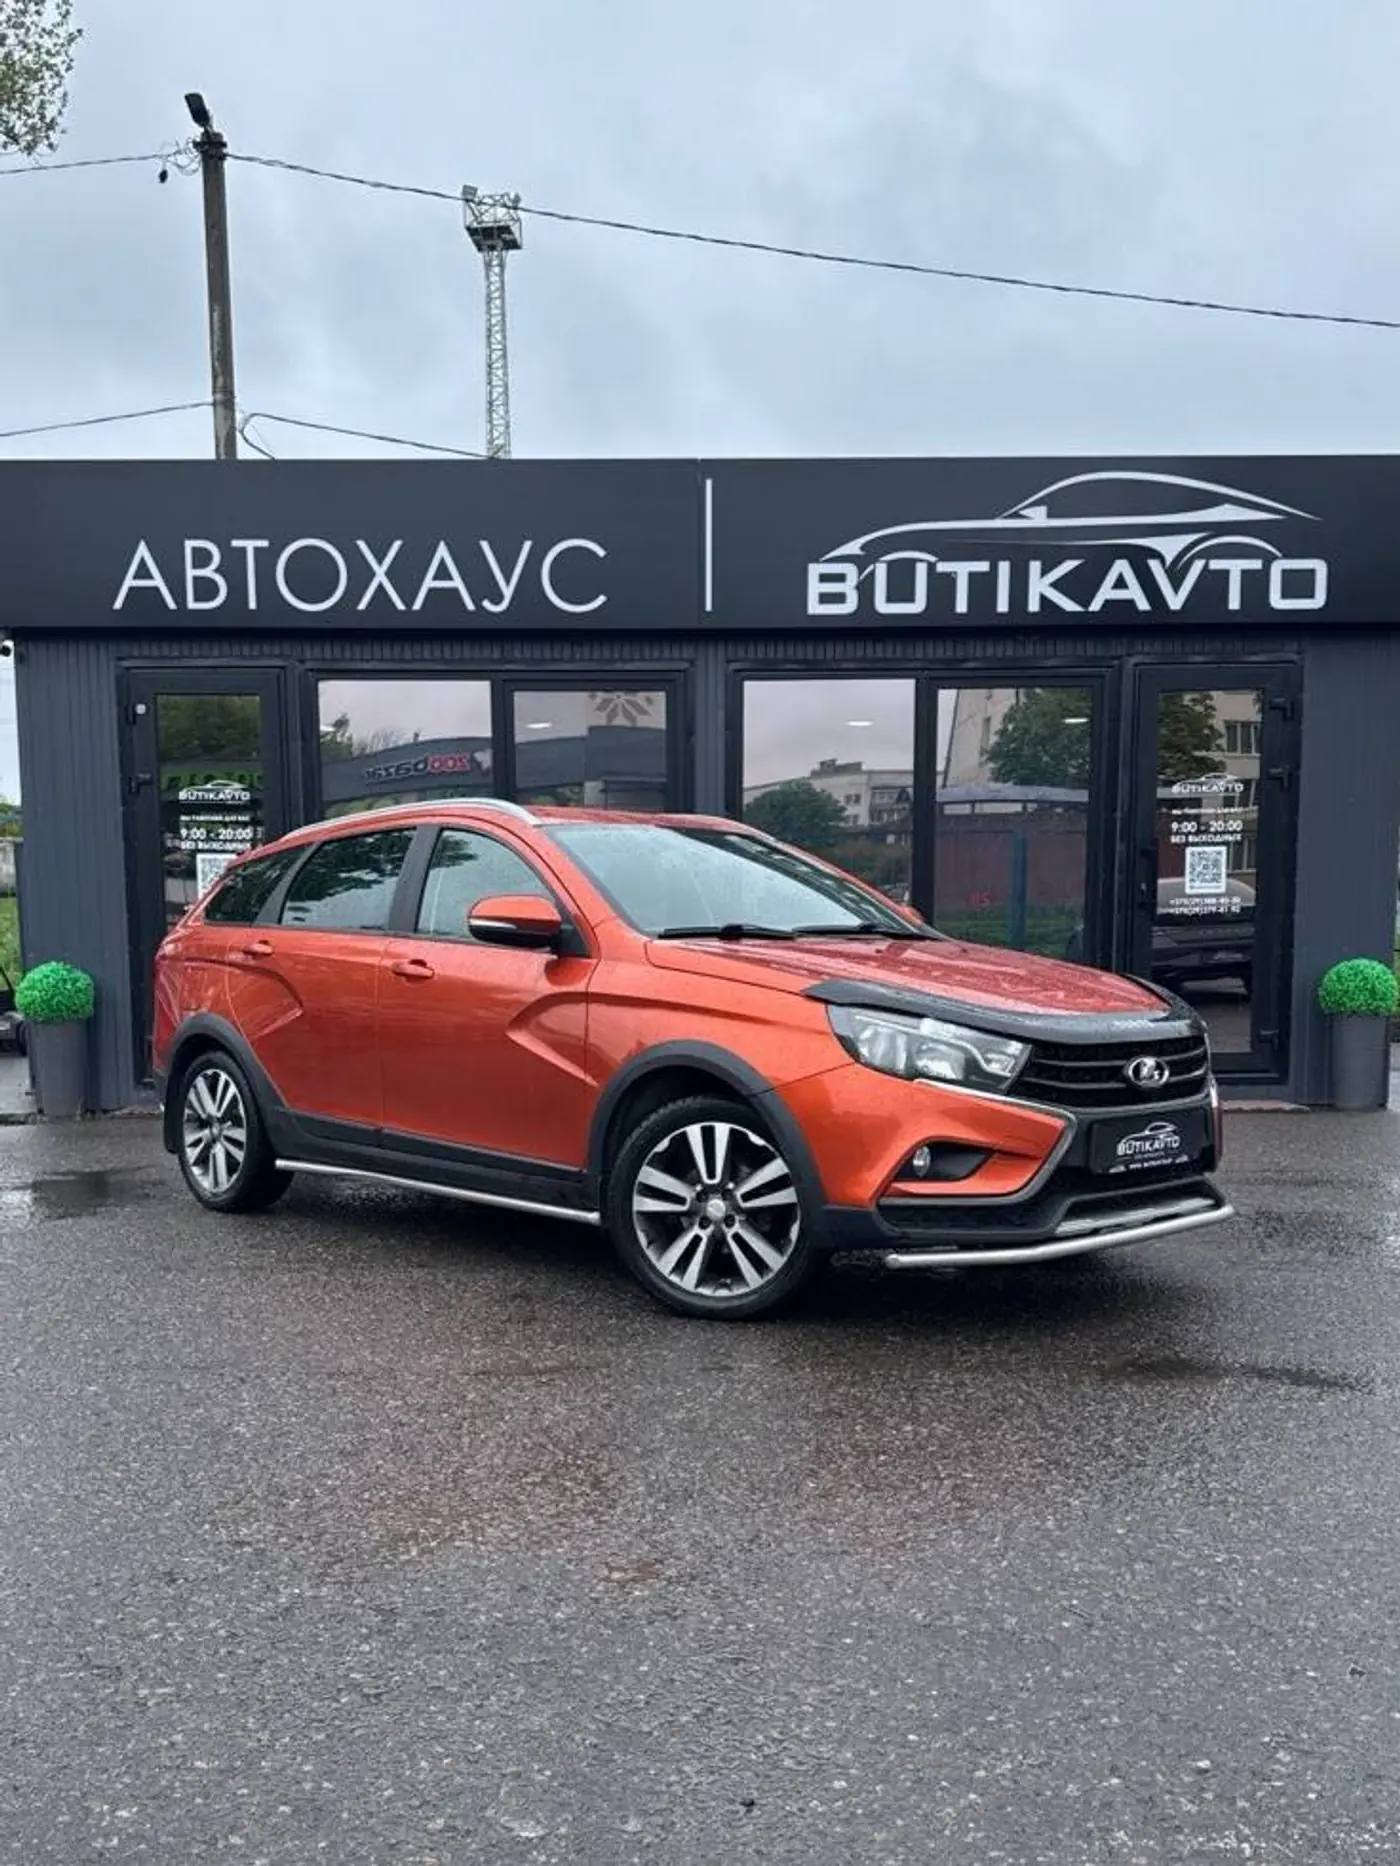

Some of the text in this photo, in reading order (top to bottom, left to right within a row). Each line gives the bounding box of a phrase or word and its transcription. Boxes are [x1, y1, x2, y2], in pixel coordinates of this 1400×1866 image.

[112, 538, 608, 613] АВТОХАУС
[806, 558, 1329, 616] BUTIKAVTO
[1171, 782, 1244, 793] BUTIKAVTO
[178, 790, 250, 800] BUTIKAVTO
[1171, 821, 1197, 832] 9:00
[1209, 820, 1243, 832] 20:00
[180, 828, 207, 839] 9:00
[218, 827, 252, 839] 20:00
[1116, 1135, 1181, 1156] BUTIKAVTO
